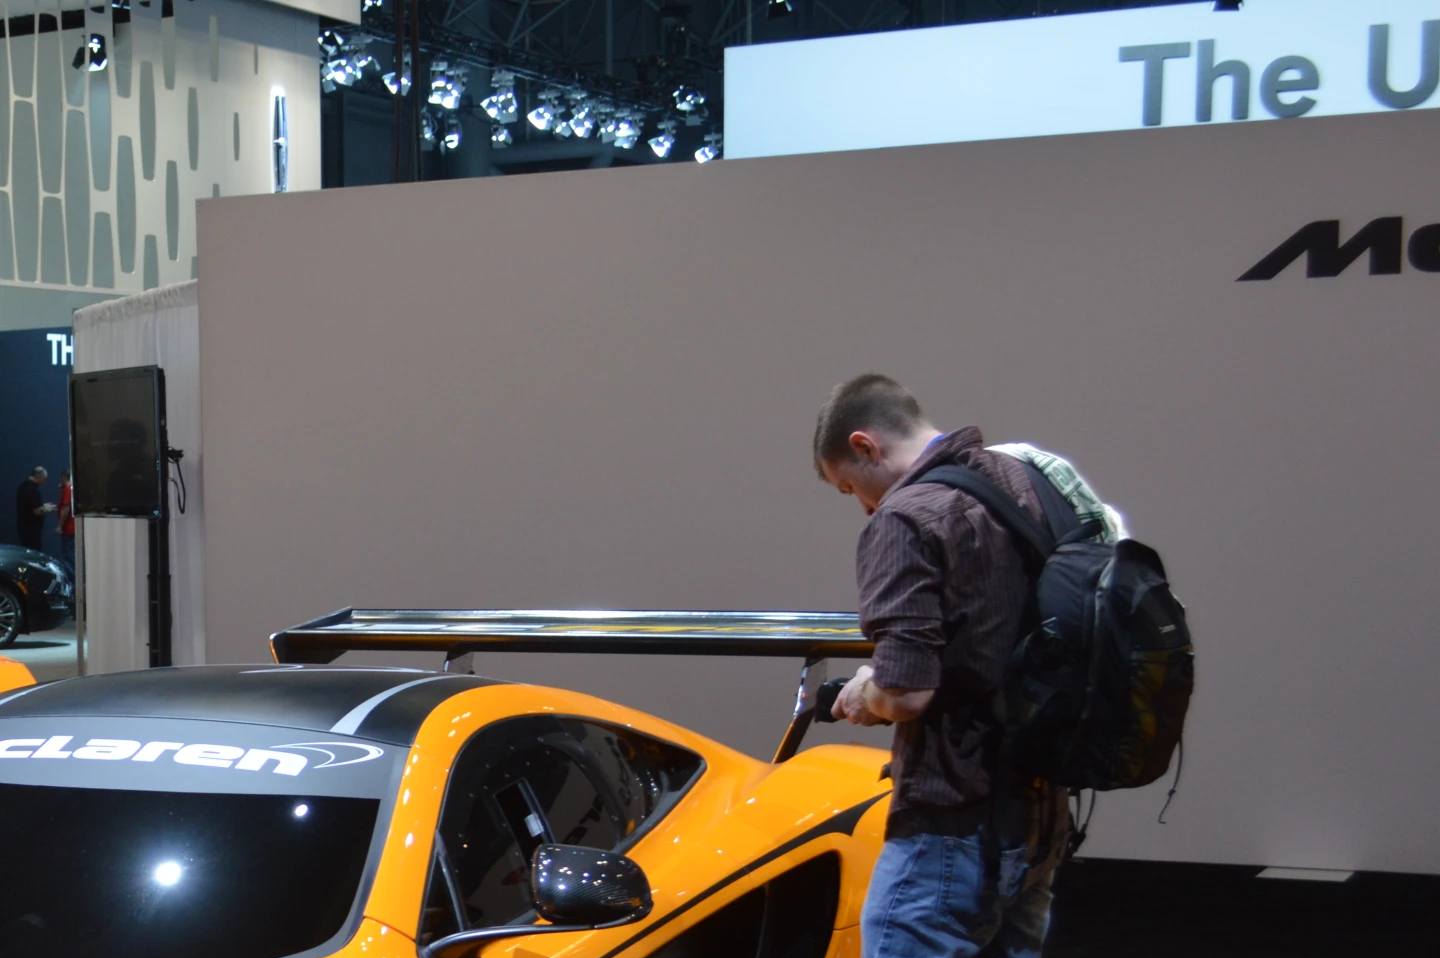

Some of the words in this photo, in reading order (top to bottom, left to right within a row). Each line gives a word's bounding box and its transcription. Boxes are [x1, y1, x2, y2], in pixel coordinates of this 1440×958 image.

[1117, 38, 1320, 127] The
[1367, 19, 1440, 110] U
[46, 333, 74, 366] TH
